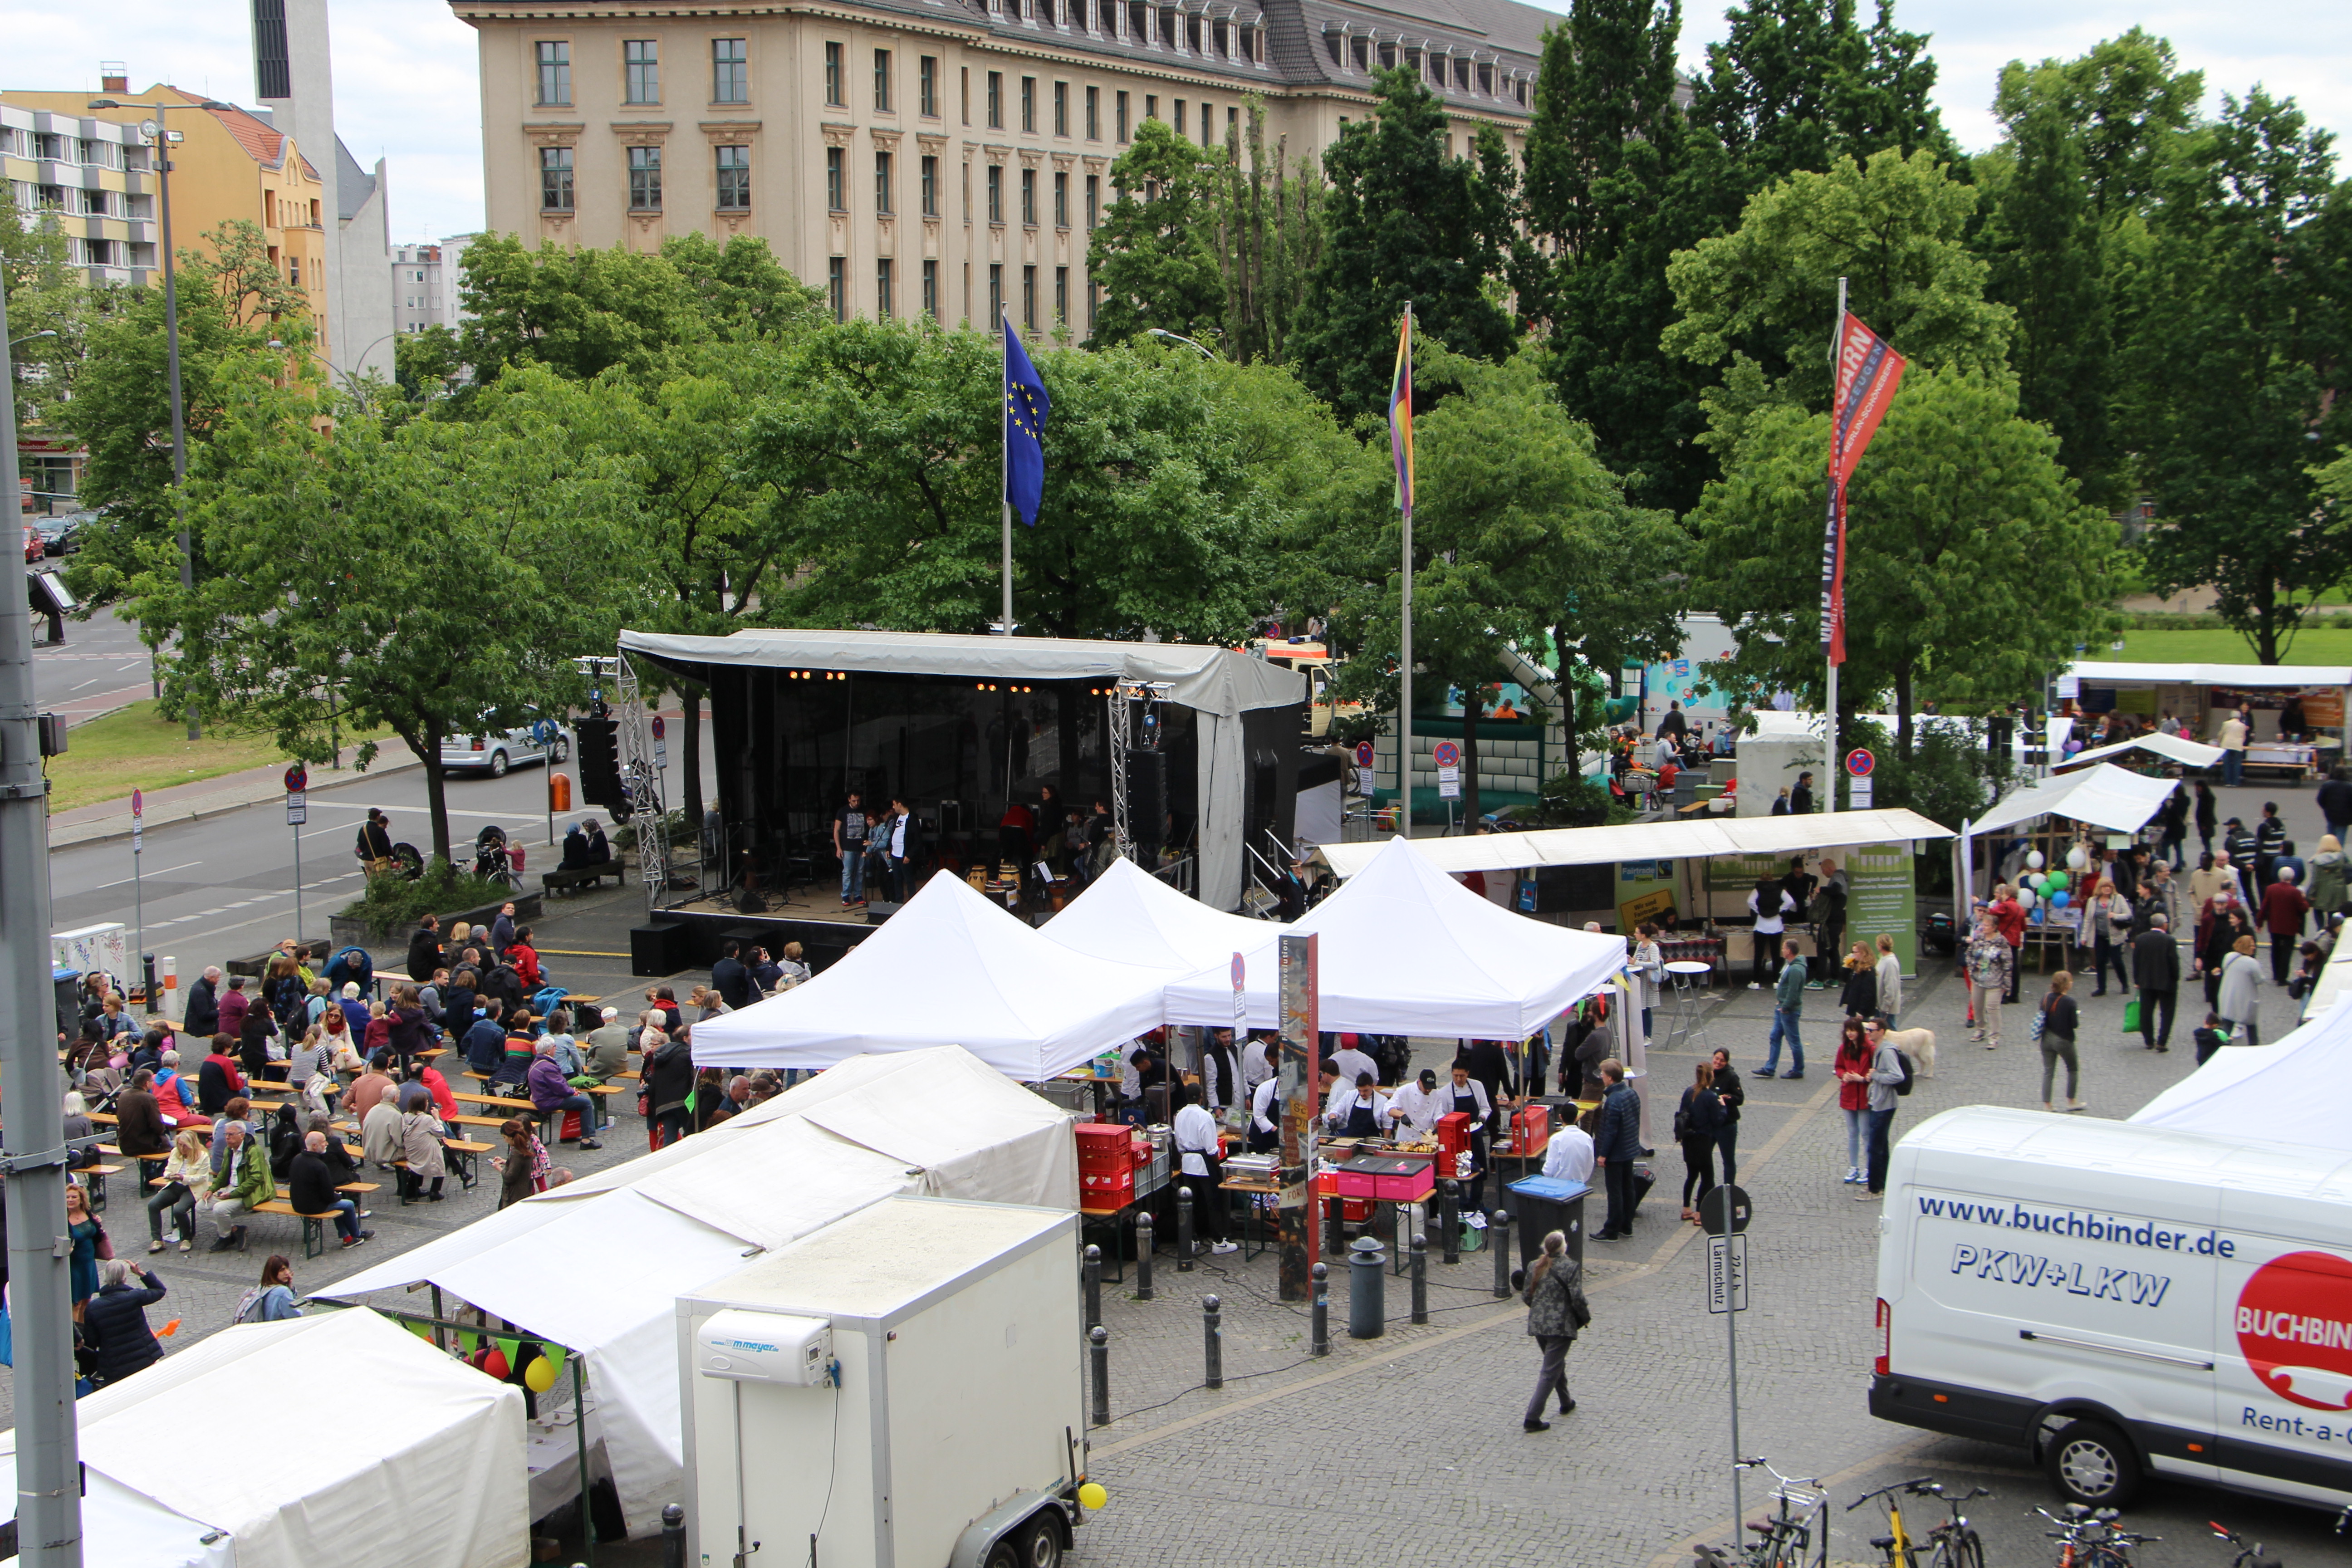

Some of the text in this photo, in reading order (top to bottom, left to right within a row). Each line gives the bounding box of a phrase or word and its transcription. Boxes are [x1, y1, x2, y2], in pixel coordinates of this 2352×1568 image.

[1844, 357, 1896, 453] BERLIN-SCHÖNEBERG
[1919, 1196, 2235, 1259] www.buchbinder.de
[1713, 1244, 1725, 1305] Lärmschutz
[1951, 1243, 2170, 1307] PKW+LKW
[2237, 1306, 2352, 1350] BUCHBIN
[2242, 1406, 2352, 1445] Rent-a-
